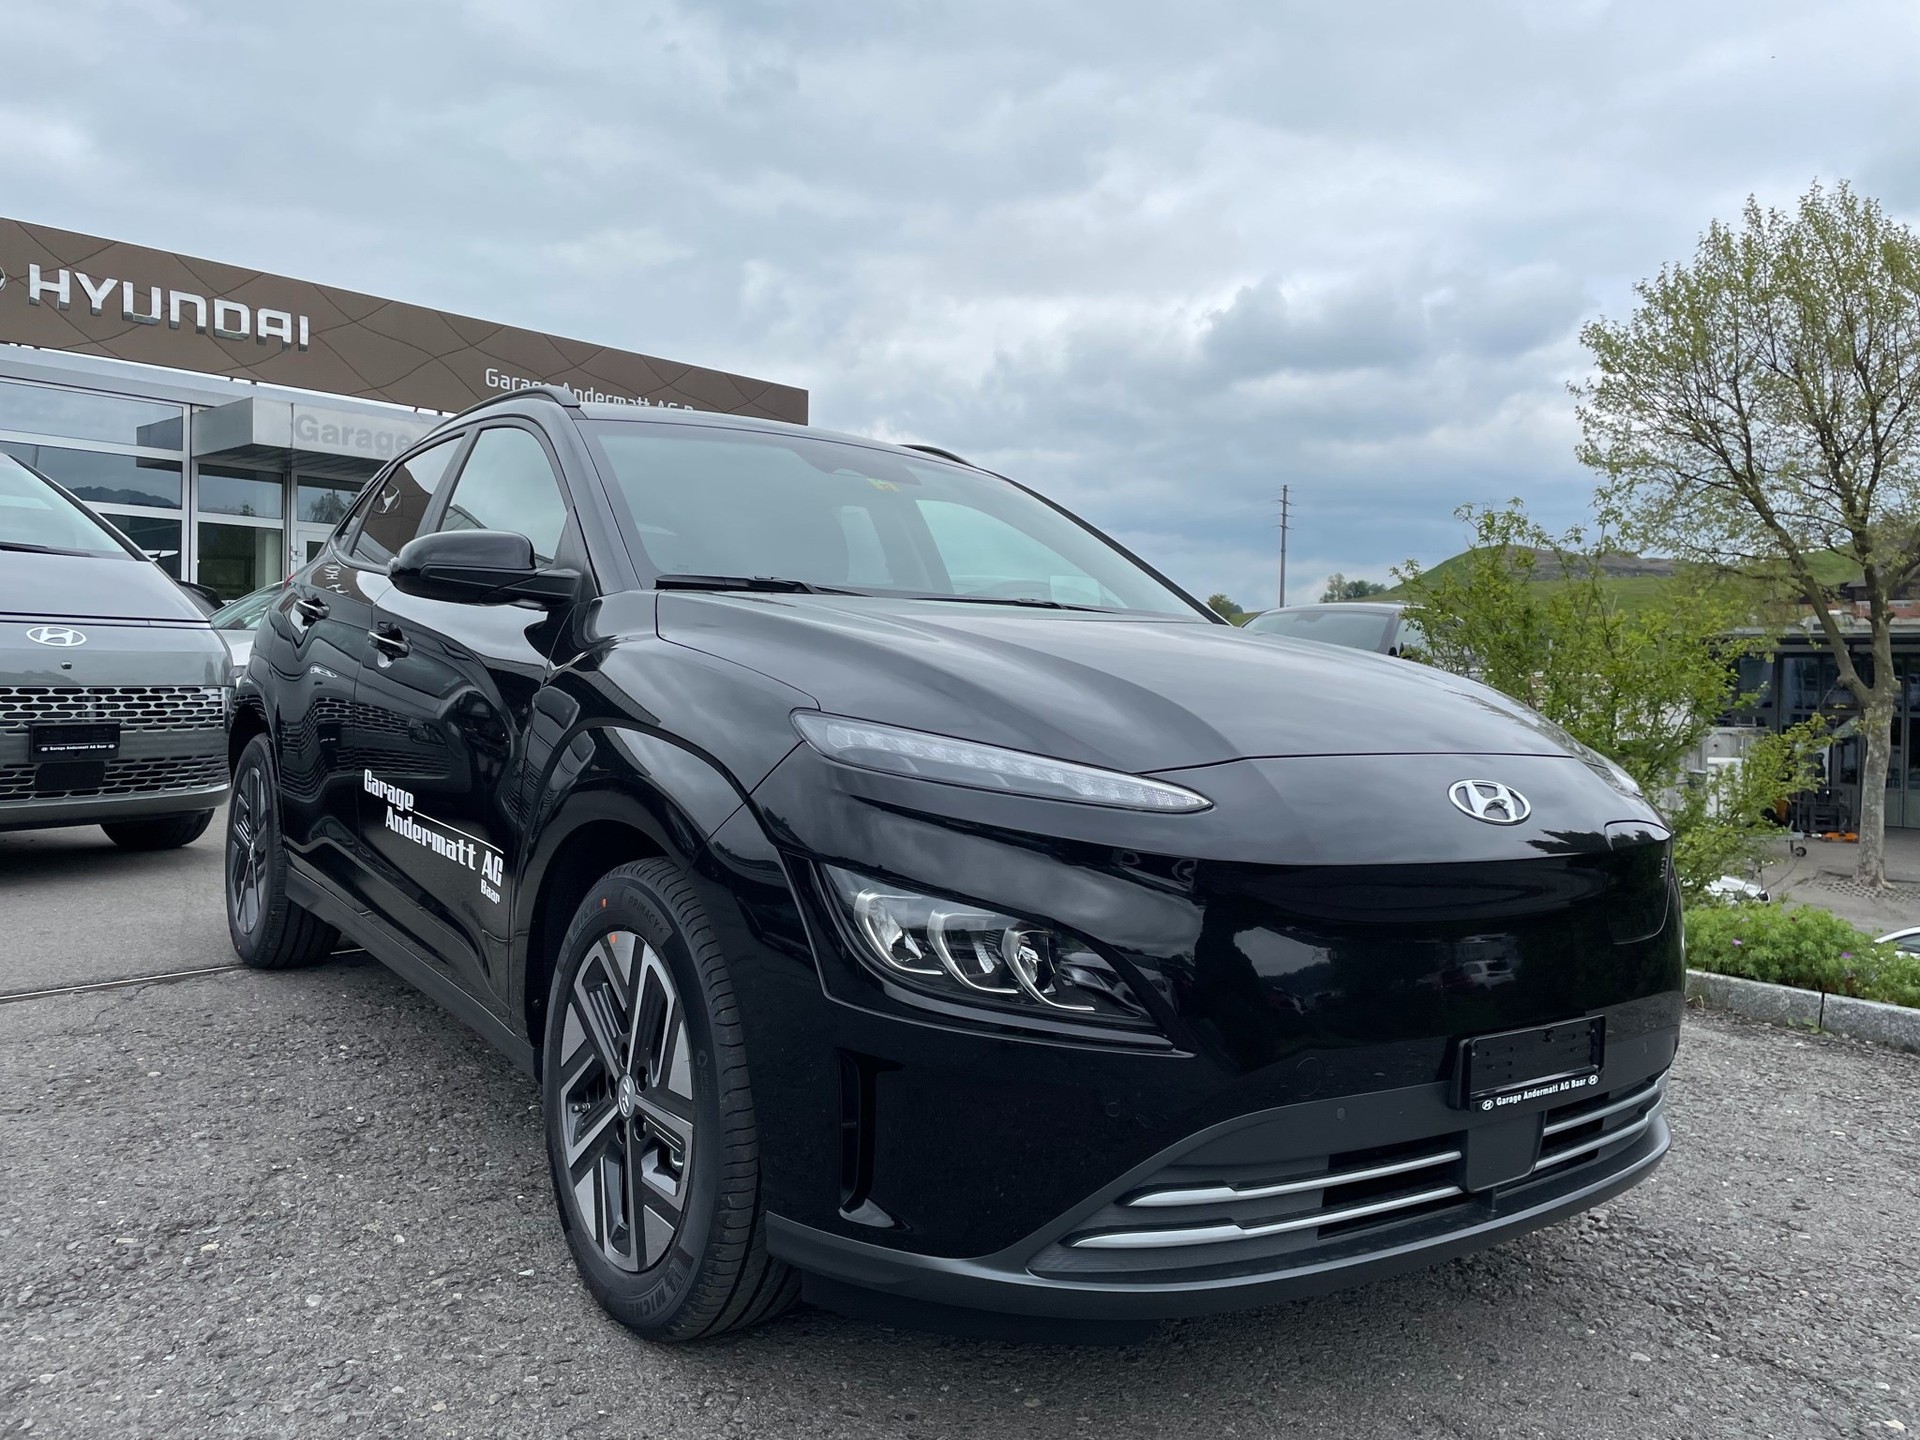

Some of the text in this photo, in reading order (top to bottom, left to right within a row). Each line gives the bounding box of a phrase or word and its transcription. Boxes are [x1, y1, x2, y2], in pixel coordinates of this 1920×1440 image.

[28, 263, 310, 352] HYUNDAI
[485, 367, 552, 392] Gara
[294, 413, 413, 458] Garage
[363, 768, 414, 812] Garage
[385, 805, 504, 887] Andermatt AG
[480, 878, 501, 905] Baar
[1496, 1078, 1587, 1106] Garage Andermatt AG Baar
